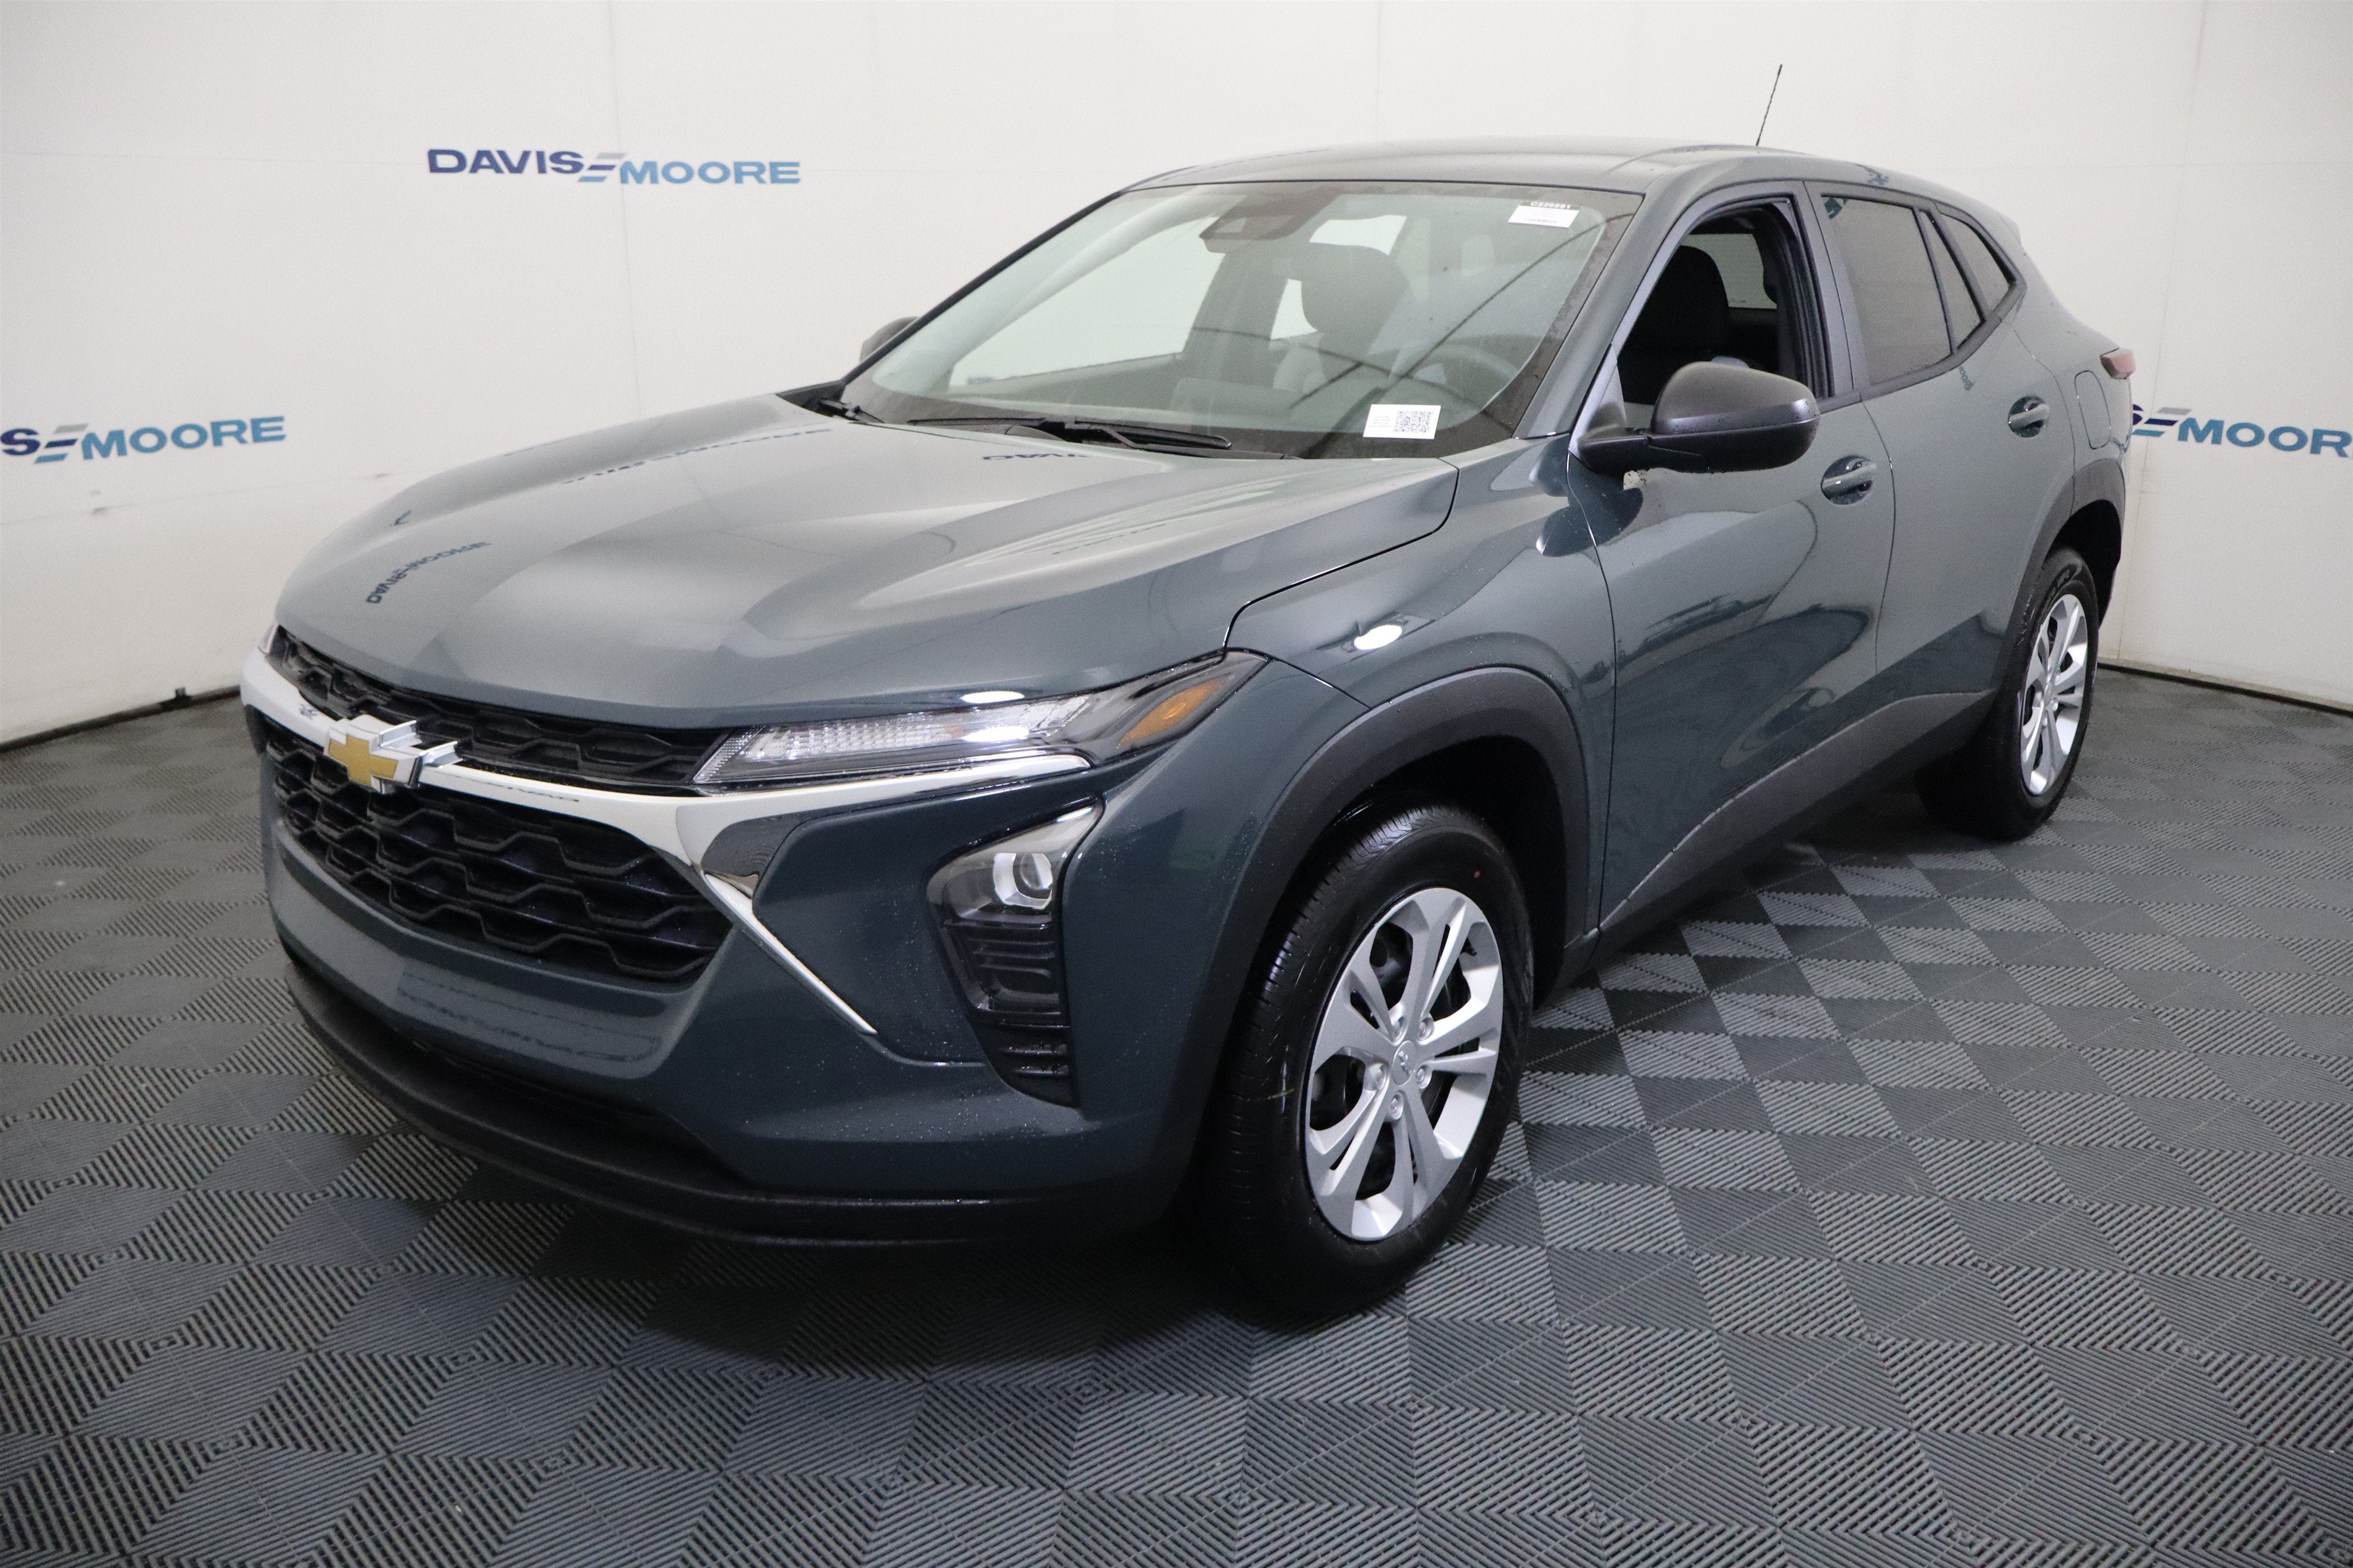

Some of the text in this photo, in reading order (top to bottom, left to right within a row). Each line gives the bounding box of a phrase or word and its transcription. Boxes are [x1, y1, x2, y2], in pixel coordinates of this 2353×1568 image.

[428, 148, 800, 184] DAVIS MOORE
[81, 416, 286, 460] MOORE
